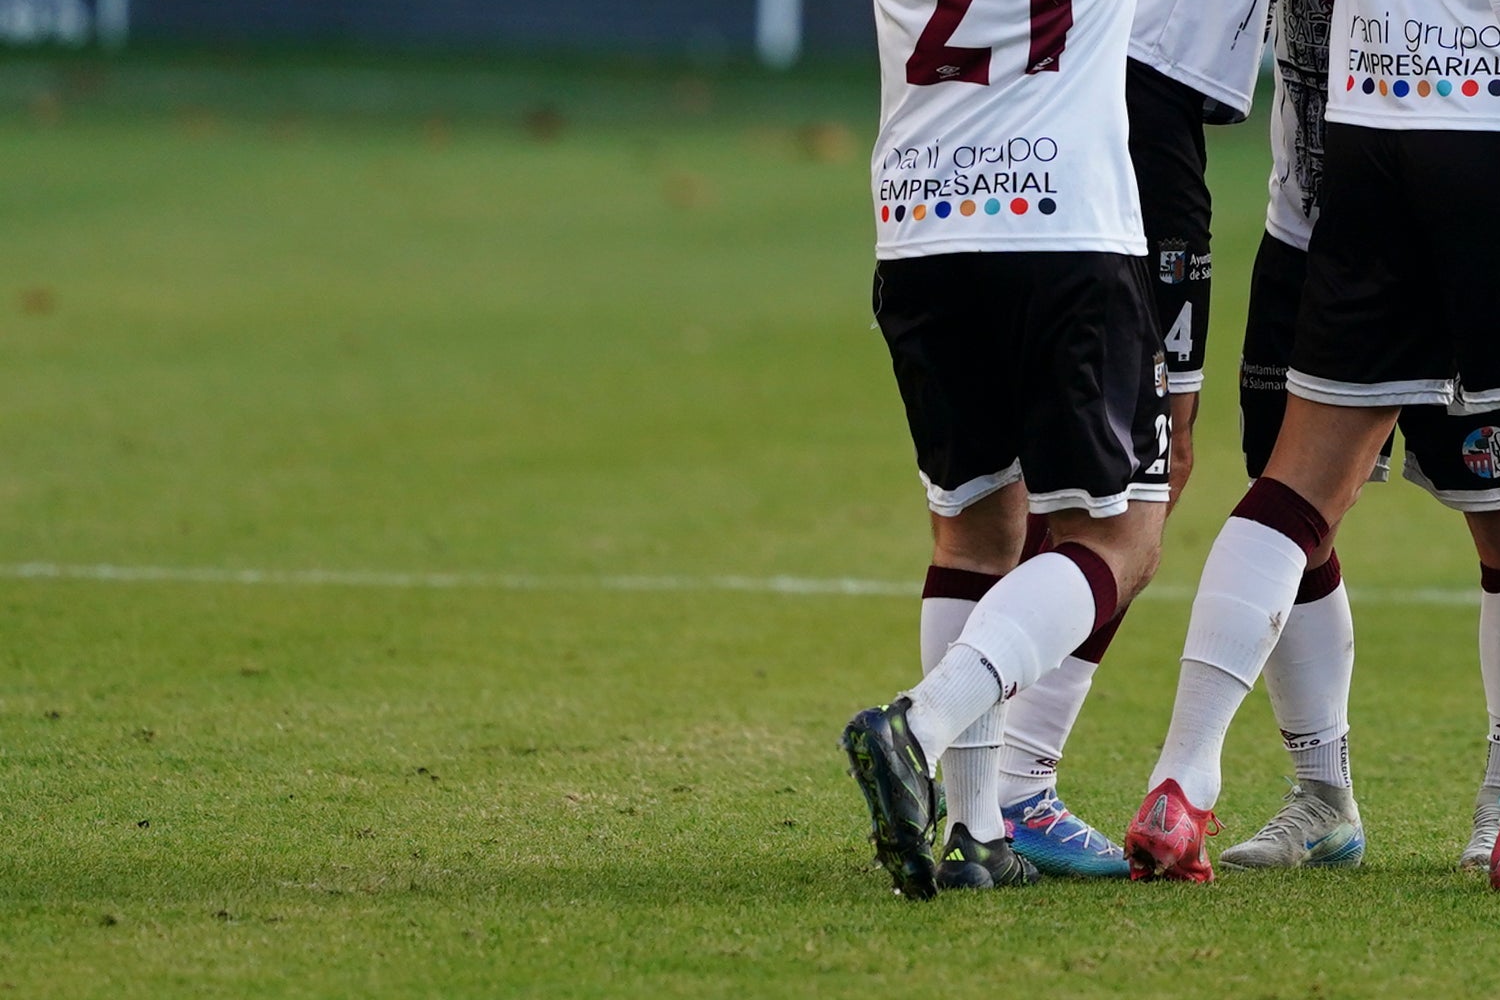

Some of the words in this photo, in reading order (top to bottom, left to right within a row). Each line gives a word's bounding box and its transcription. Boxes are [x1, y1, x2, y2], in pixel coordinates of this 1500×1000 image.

[953, 136, 1058, 170] grupo
[880, 170, 1058, 201] EMPRESARIAL
[1163, 299, 1193, 362] 4
